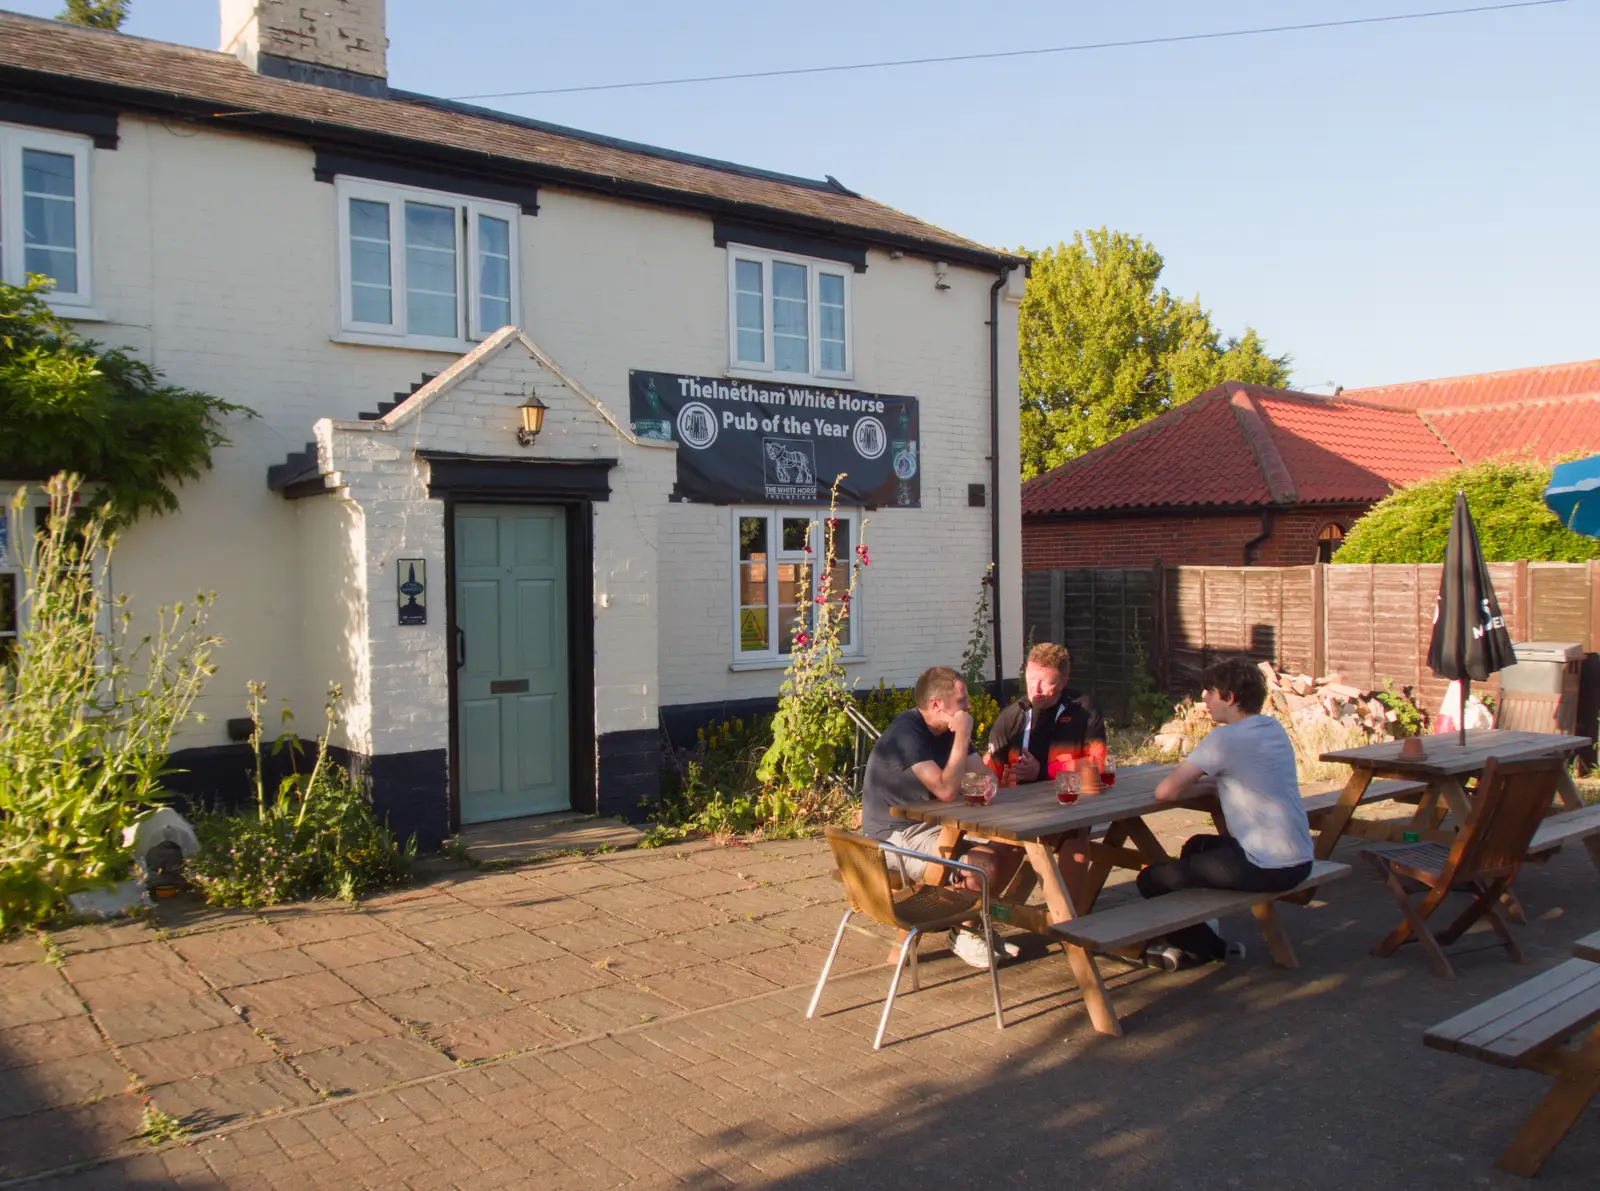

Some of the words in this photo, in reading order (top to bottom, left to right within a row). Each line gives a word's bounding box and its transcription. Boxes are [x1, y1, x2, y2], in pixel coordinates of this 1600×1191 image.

[678, 378, 785, 404] Thelnetham
[788, 388, 836, 410] White
[839, 393, 885, 414] Horse
[722, 411, 758, 431] Pub
[761, 414, 780, 433] of
[783, 415, 811, 435] the
[813, 418, 850, 438] Year
